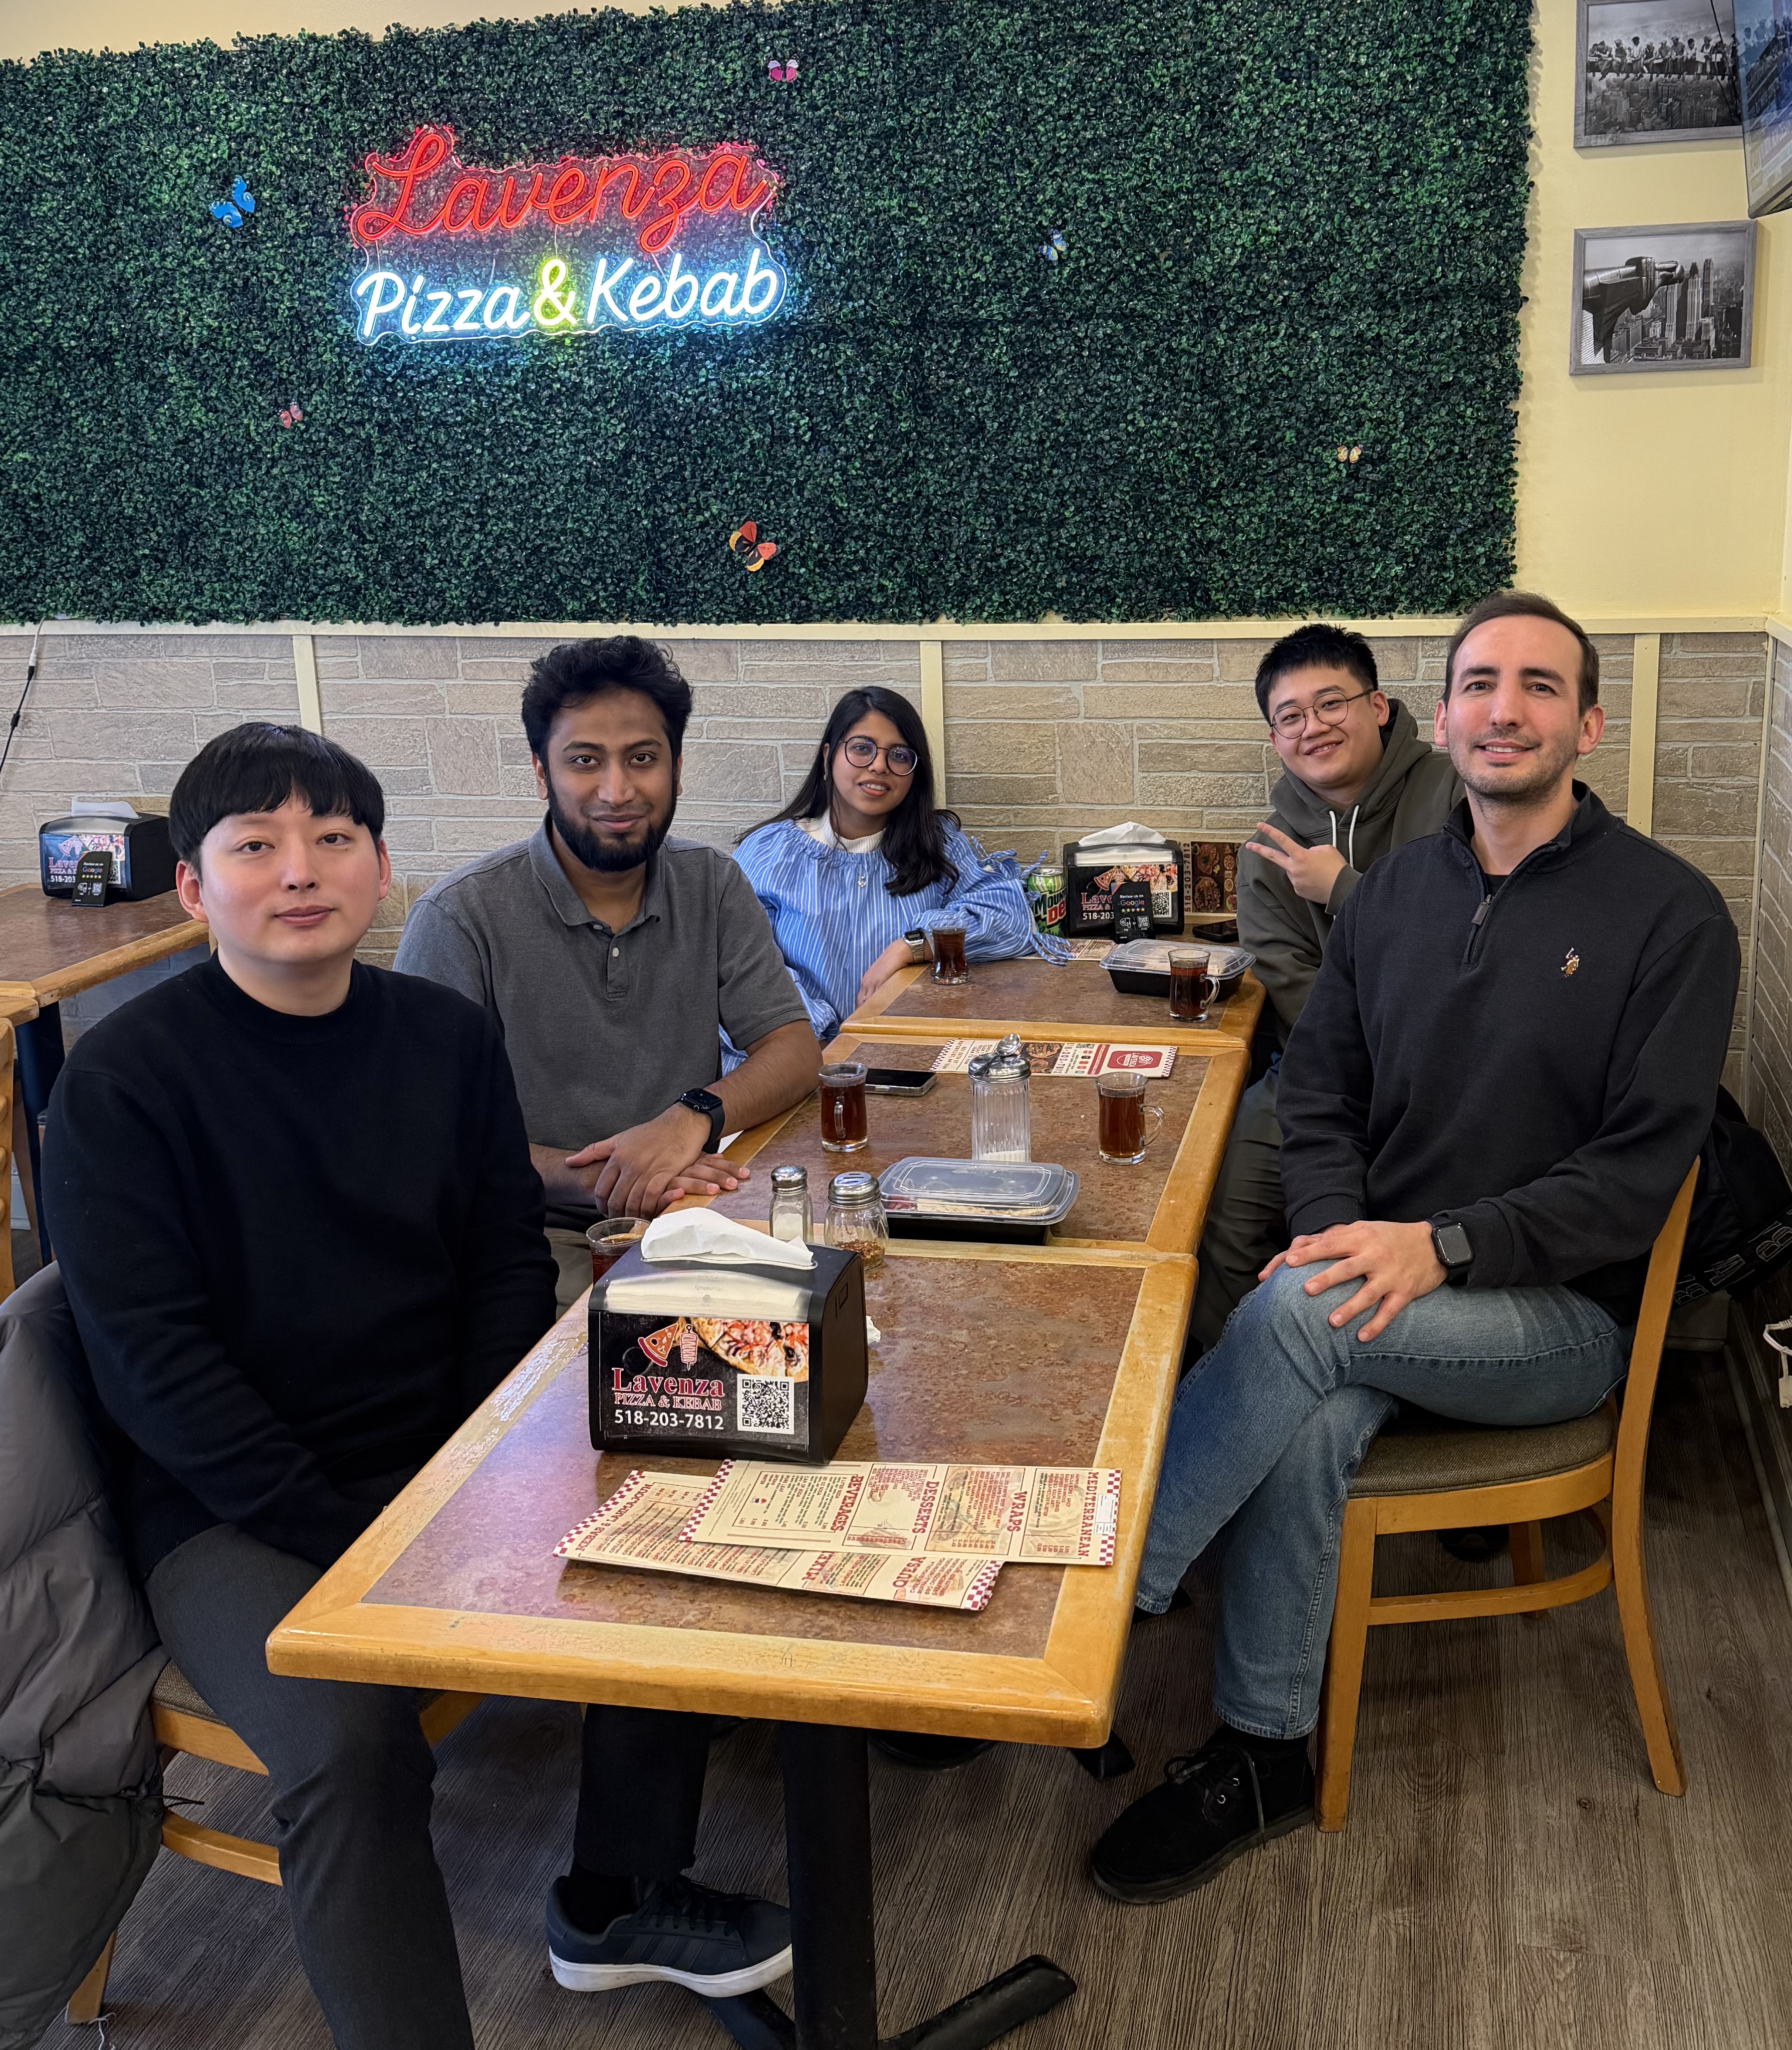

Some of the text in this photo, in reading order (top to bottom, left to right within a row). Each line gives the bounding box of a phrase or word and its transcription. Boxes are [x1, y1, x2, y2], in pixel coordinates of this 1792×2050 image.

[357, 131, 766, 253] Lavenza
[357, 248, 778, 336] Pizza & Kebab
[612, 1368, 725, 1398] Lavenza
[614, 1393, 722, 1412] PIZZA & KEBAB
[614, 1411, 724, 1431] 518-203-7812
[573, 1526, 606, 1551] KEBAB
[611, 1483, 654, 1522] LAHMAJOUN
[829, 1475, 865, 1531] BEVERAGES
[910, 1481, 940, 1534] DESSERTS
[1005, 1490, 1028, 1532] WRAPS
[1077, 1471, 1099, 1556] MEDITERRANEAN
